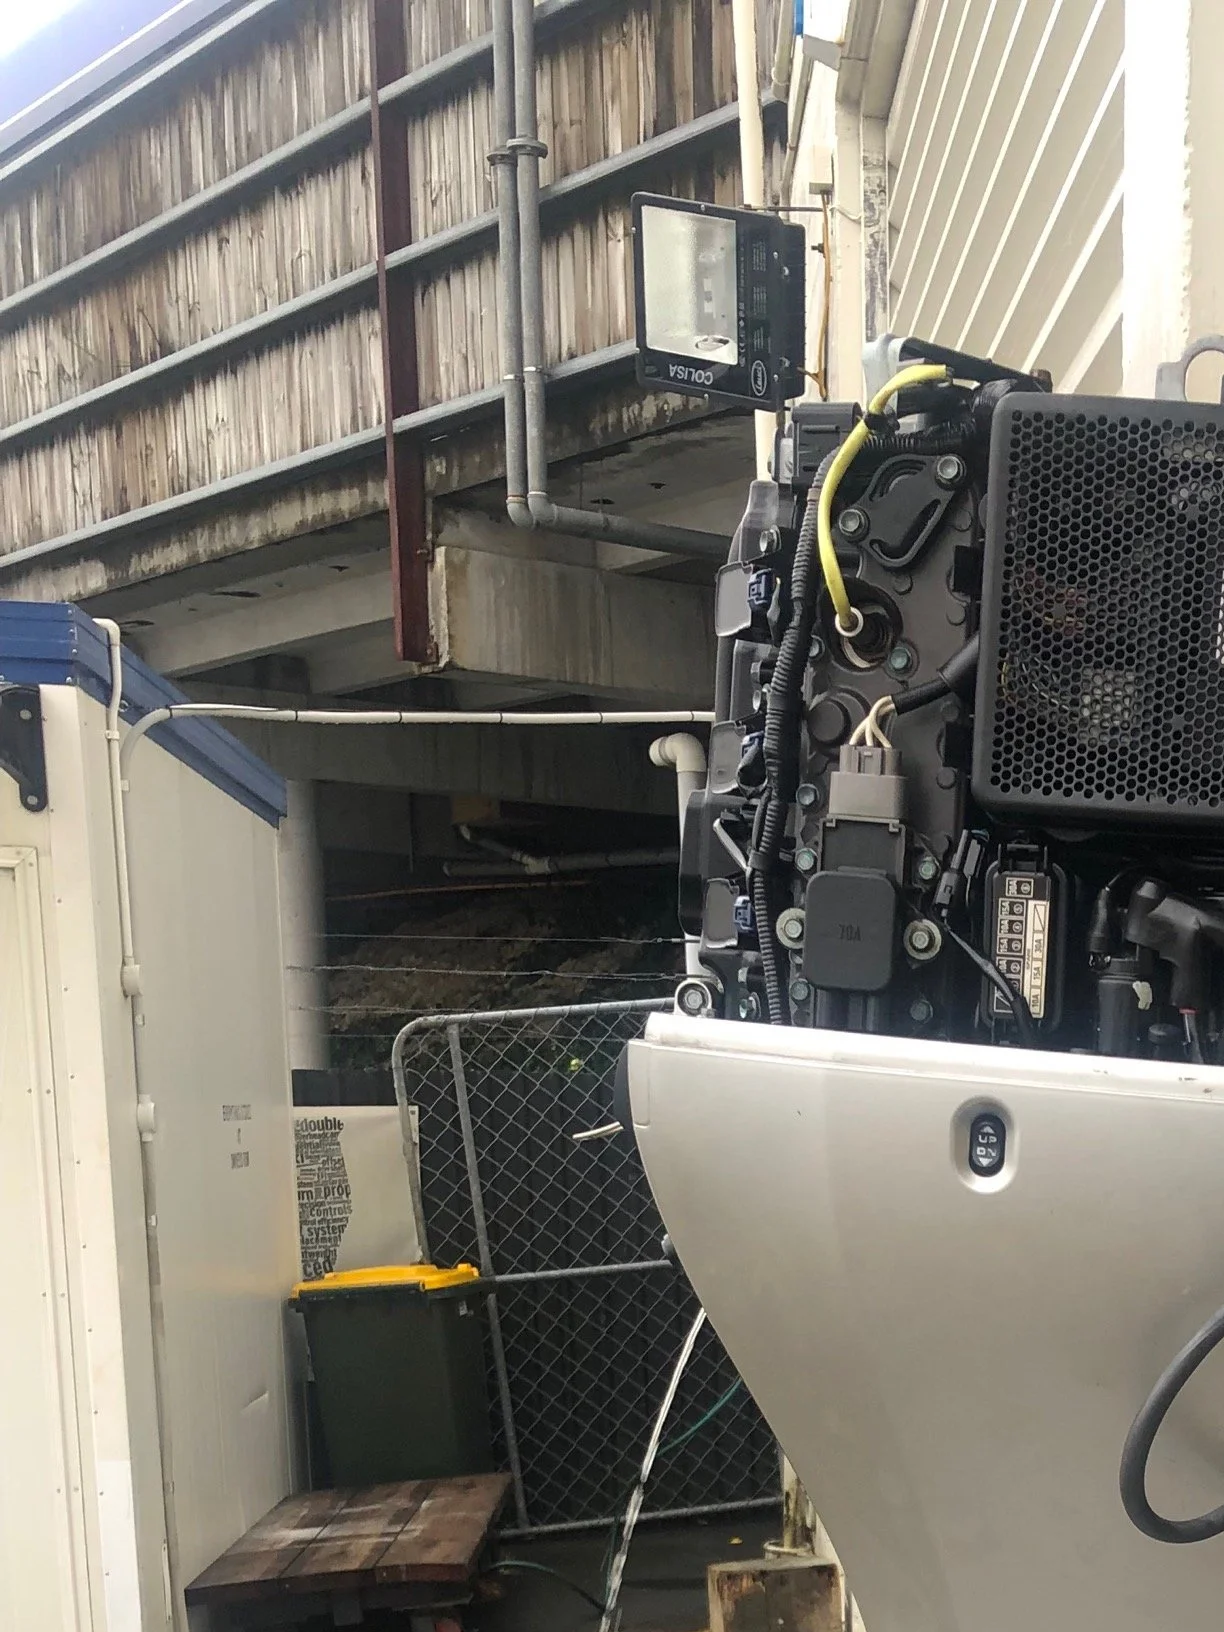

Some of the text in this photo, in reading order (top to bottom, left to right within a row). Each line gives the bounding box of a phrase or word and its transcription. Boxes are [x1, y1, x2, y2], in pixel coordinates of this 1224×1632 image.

[669, 364, 714, 385] COLISA
[1033, 966, 1041, 980] 15A
[1031, 993, 1039, 1008] 10A
[978, 1134, 998, 1144] UP
[976, 1146, 997, 1157] DN
